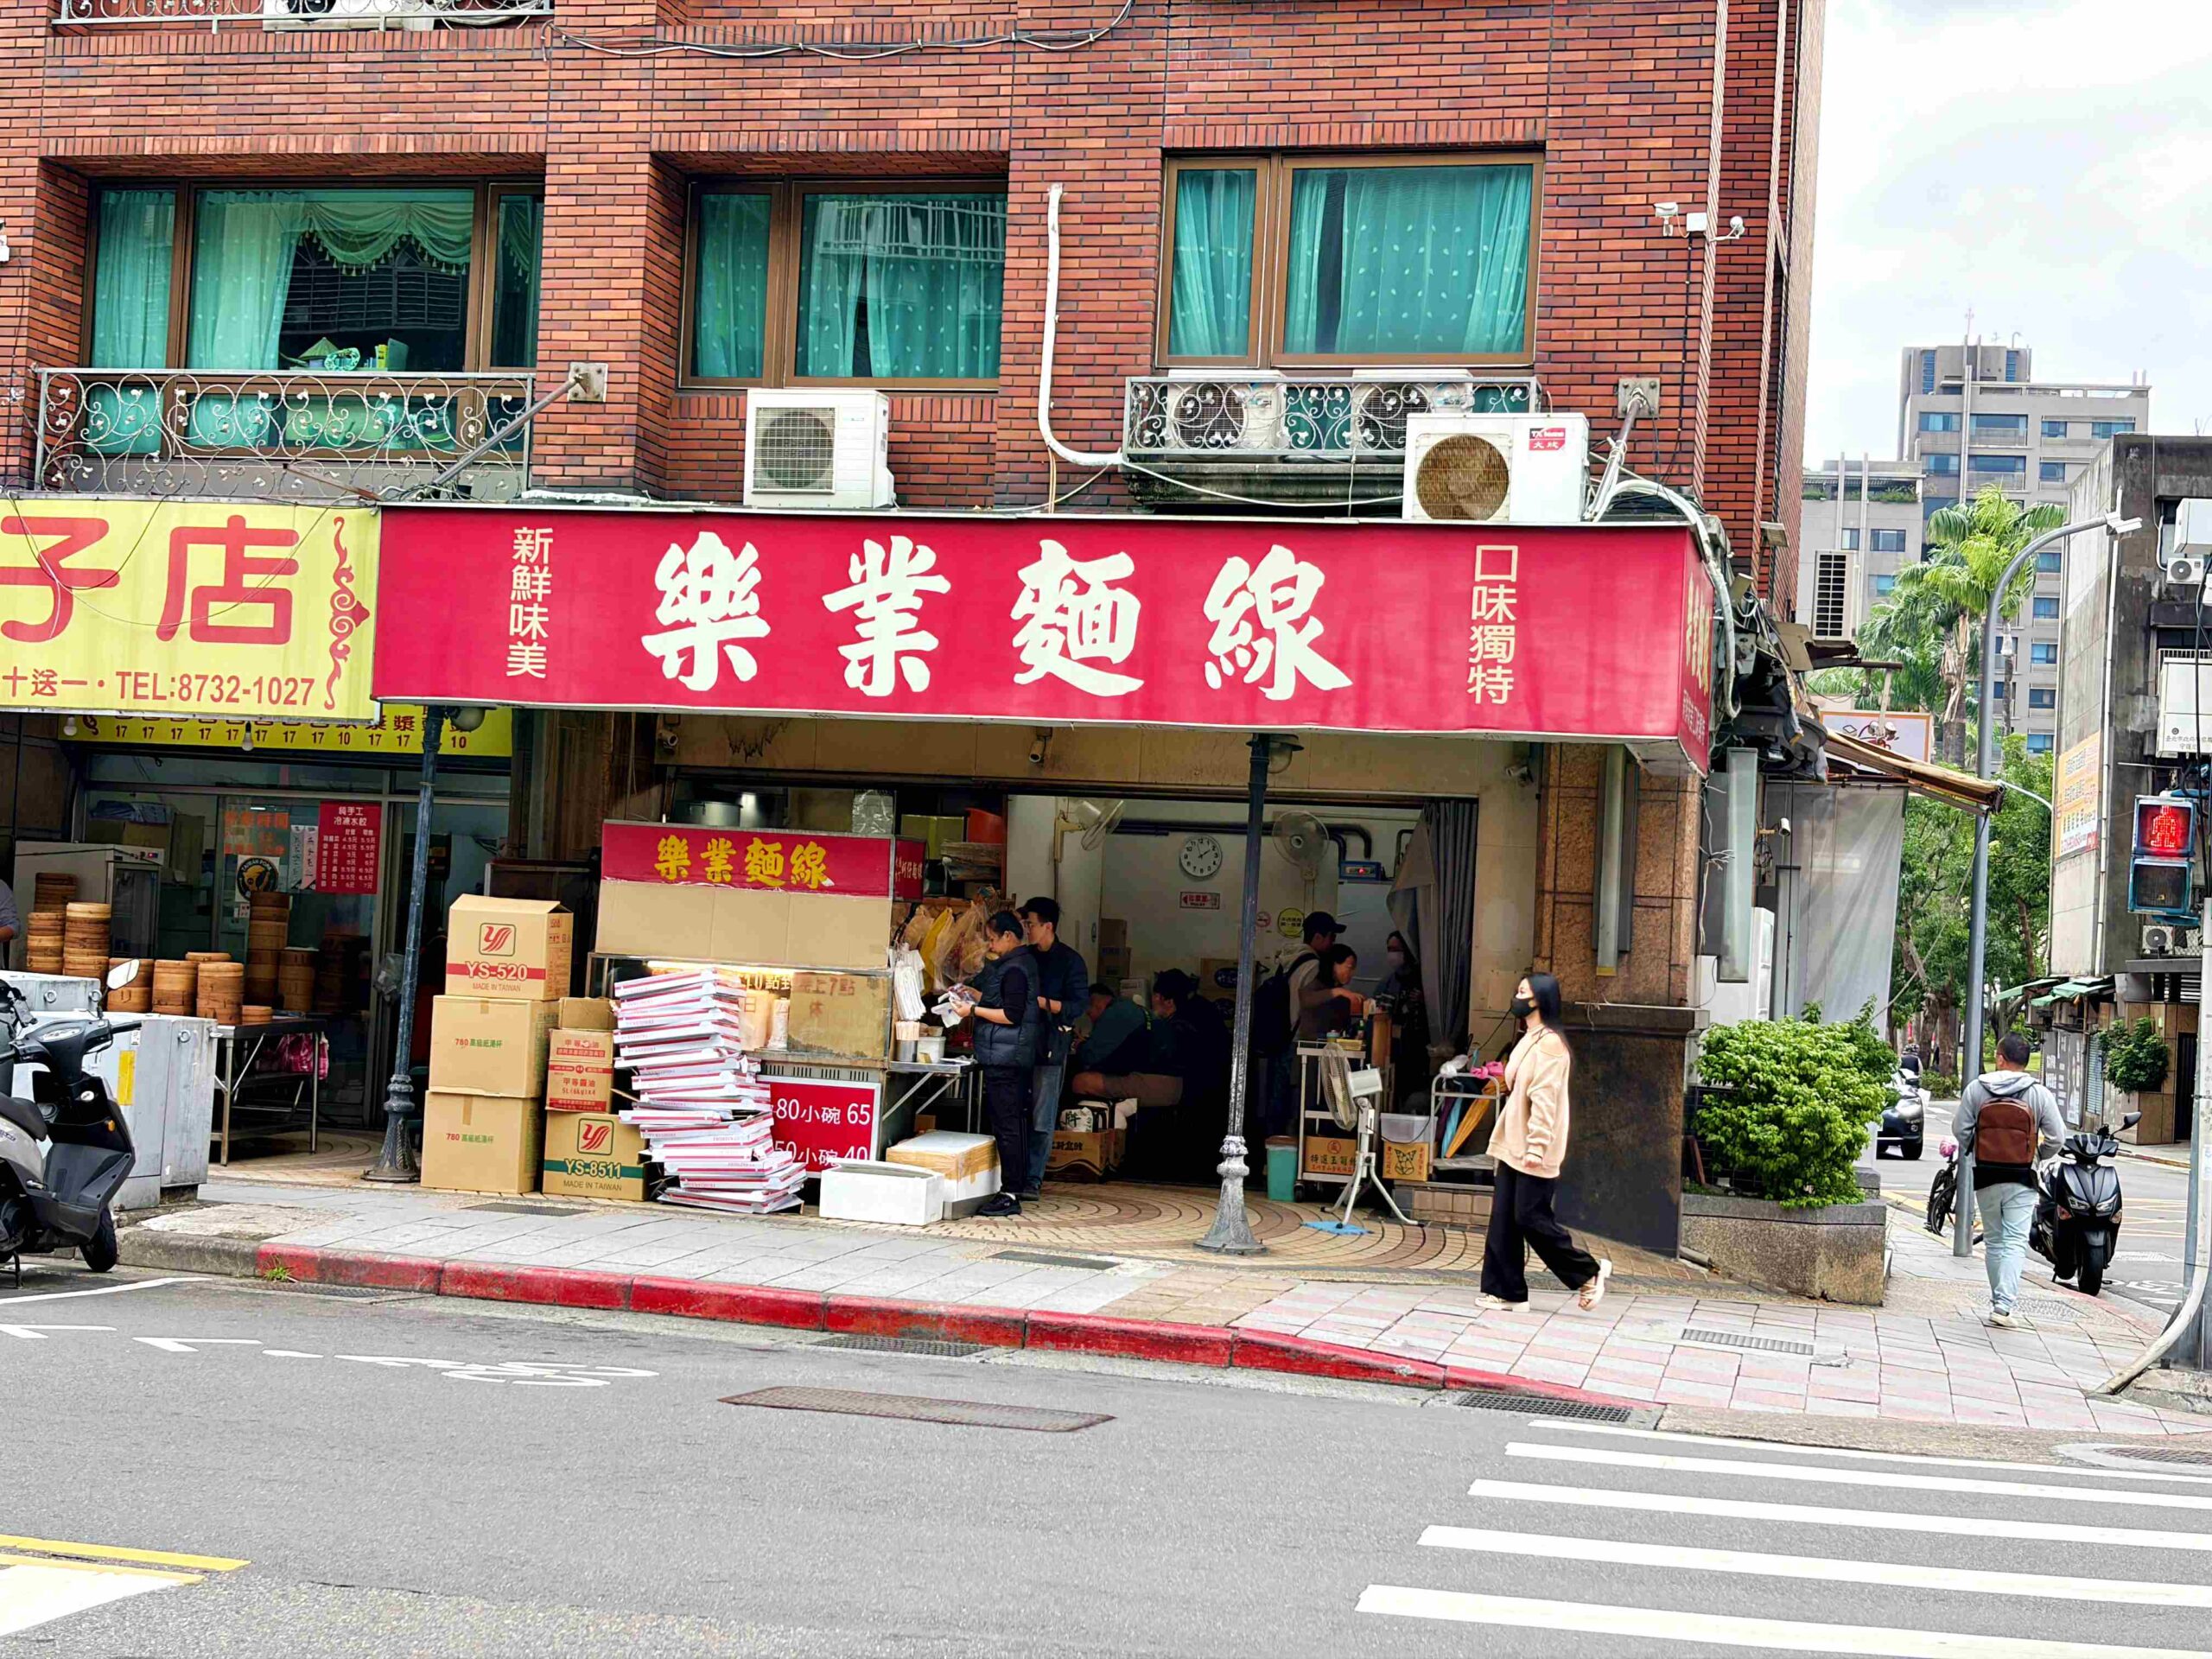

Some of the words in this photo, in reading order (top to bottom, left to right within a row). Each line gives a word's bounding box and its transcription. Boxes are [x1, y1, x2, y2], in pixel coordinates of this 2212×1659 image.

[0, 515, 300, 645] 子店
[506, 526, 553, 678] 新鮮味美
[641, 531, 1353, 701] 樂業麵線
[1467, 545, 1518, 704] 口味獨特
[116, 671, 315, 705] TEL:8732-1027
[116, 725, 127, 737] 17
[143, 727, 155, 739] 17
[171, 728, 183, 741] 17
[199, 728, 212, 741] 17
[226, 728, 238, 741] 17
[255, 729, 268, 742] 17
[283, 731, 296, 744] 17
[312, 731, 324, 744] 17
[338, 732, 351, 745] 10
[368, 734, 382, 747] 17
[397, 734, 410, 747] 17
[451, 736, 467, 749] 10
[654, 835, 835, 888] 樂業麵線
[465, 961, 528, 982] YS-520
[499, 983, 521, 992] TAIWAN
[455, 1038, 468, 1046] 780
[847, 1103, 871, 1125] 65
[563, 1159, 622, 1179] YS-8511
[563, 1179, 583, 1189] MADE
[585, 1181, 594, 1190] IN
[594, 1182, 622, 1192] TAIWAN
